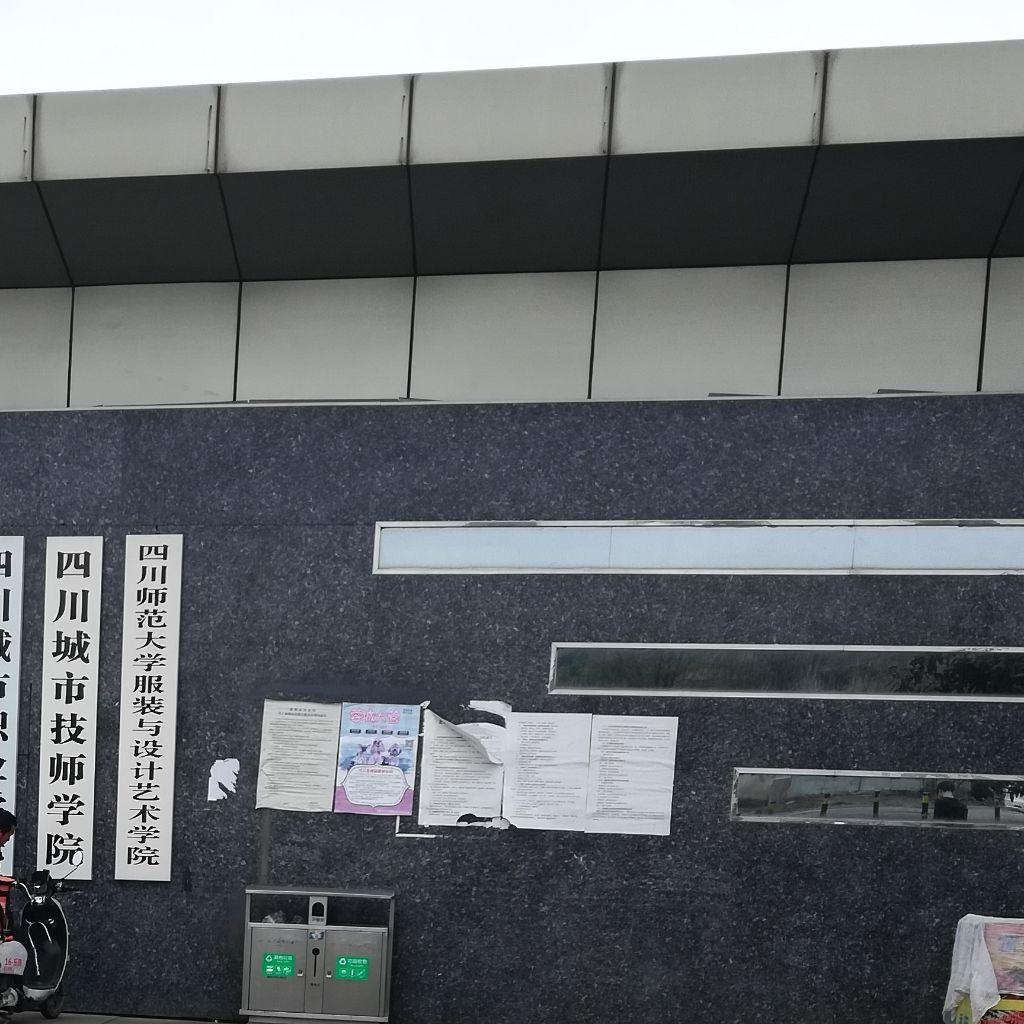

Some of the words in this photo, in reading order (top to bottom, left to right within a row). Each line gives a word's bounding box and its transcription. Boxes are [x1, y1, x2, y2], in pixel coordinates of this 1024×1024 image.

[46, 550, 92, 866] 四川城市技师学院
[127, 544, 169, 865] 四川师范大学服装与设计艺术学院
